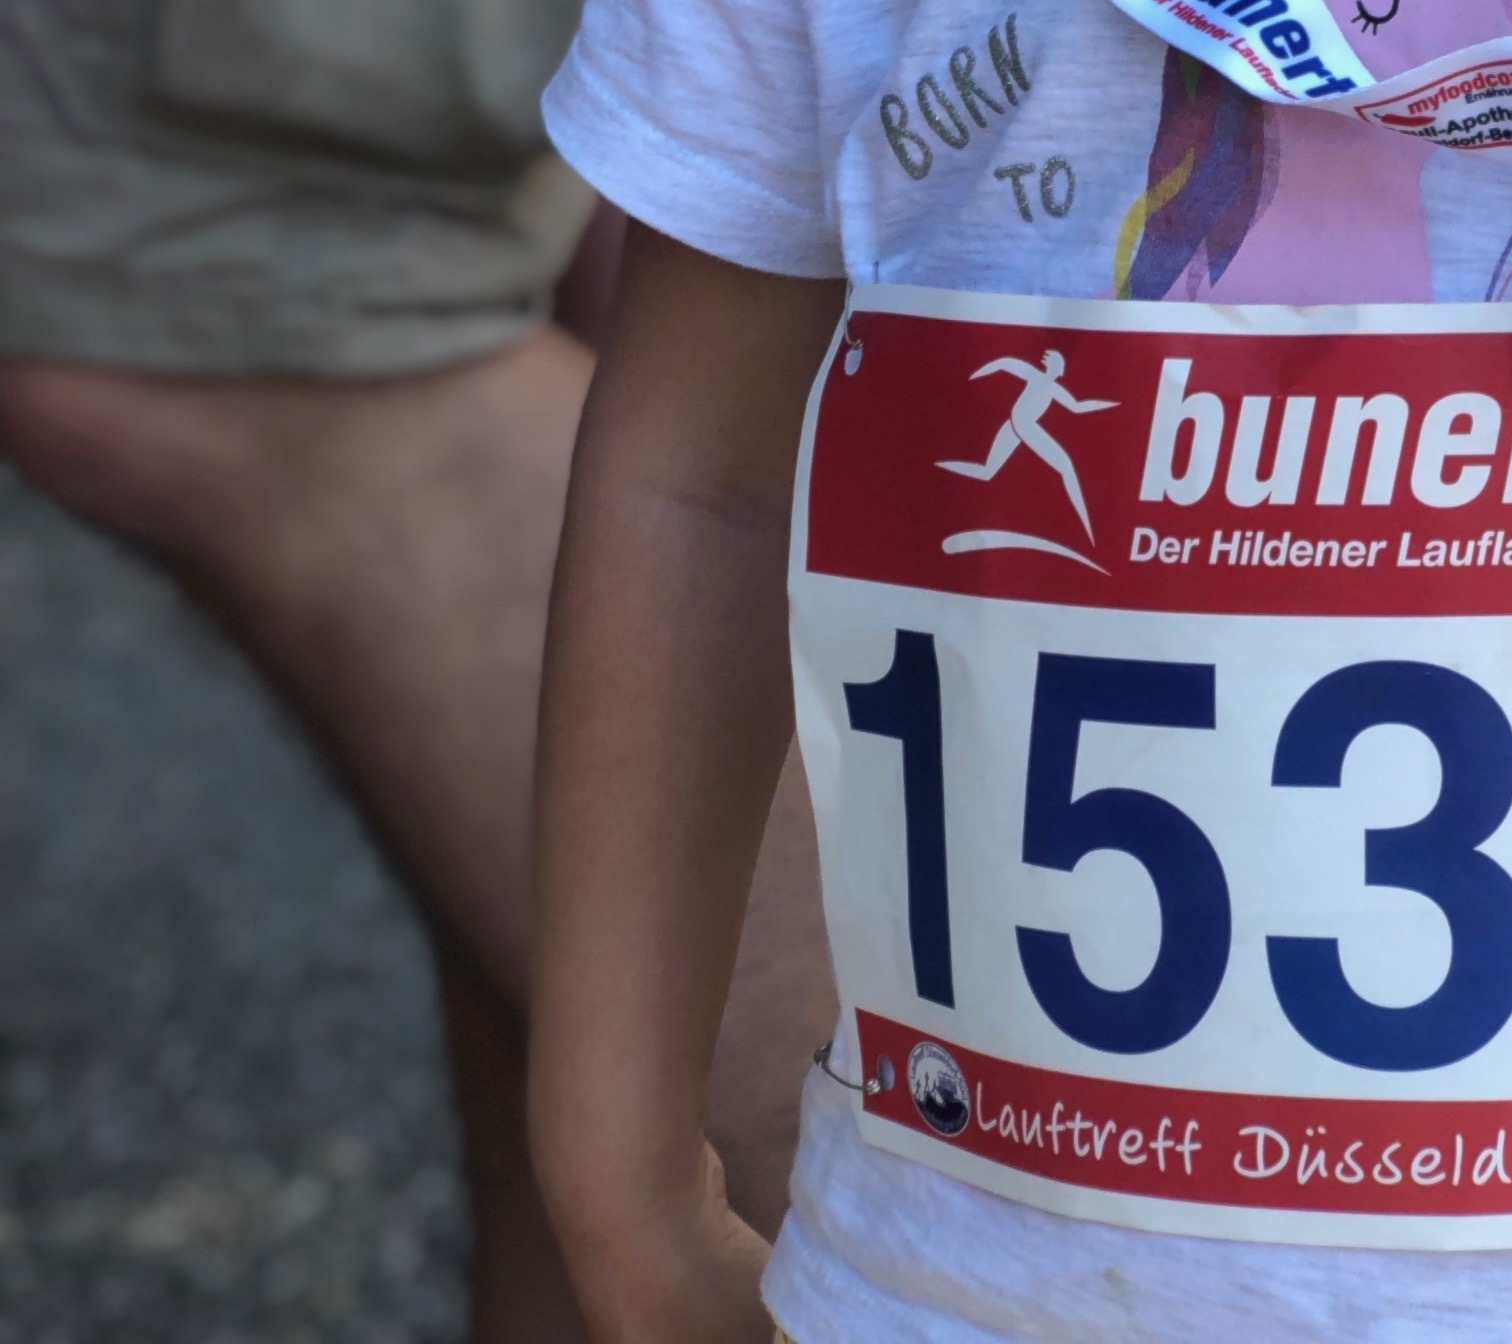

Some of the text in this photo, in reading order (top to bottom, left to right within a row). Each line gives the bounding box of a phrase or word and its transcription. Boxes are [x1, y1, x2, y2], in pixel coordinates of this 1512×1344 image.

[1168, 0, 1234, 41] Hildener
[880, 12, 1031, 180] BORN
[993, 155, 1075, 223] TO
[1129, 527, 1199, 564] Der
[1208, 529, 1387, 567] Hildener
[975, 1080, 1203, 1175] Lauftreff
